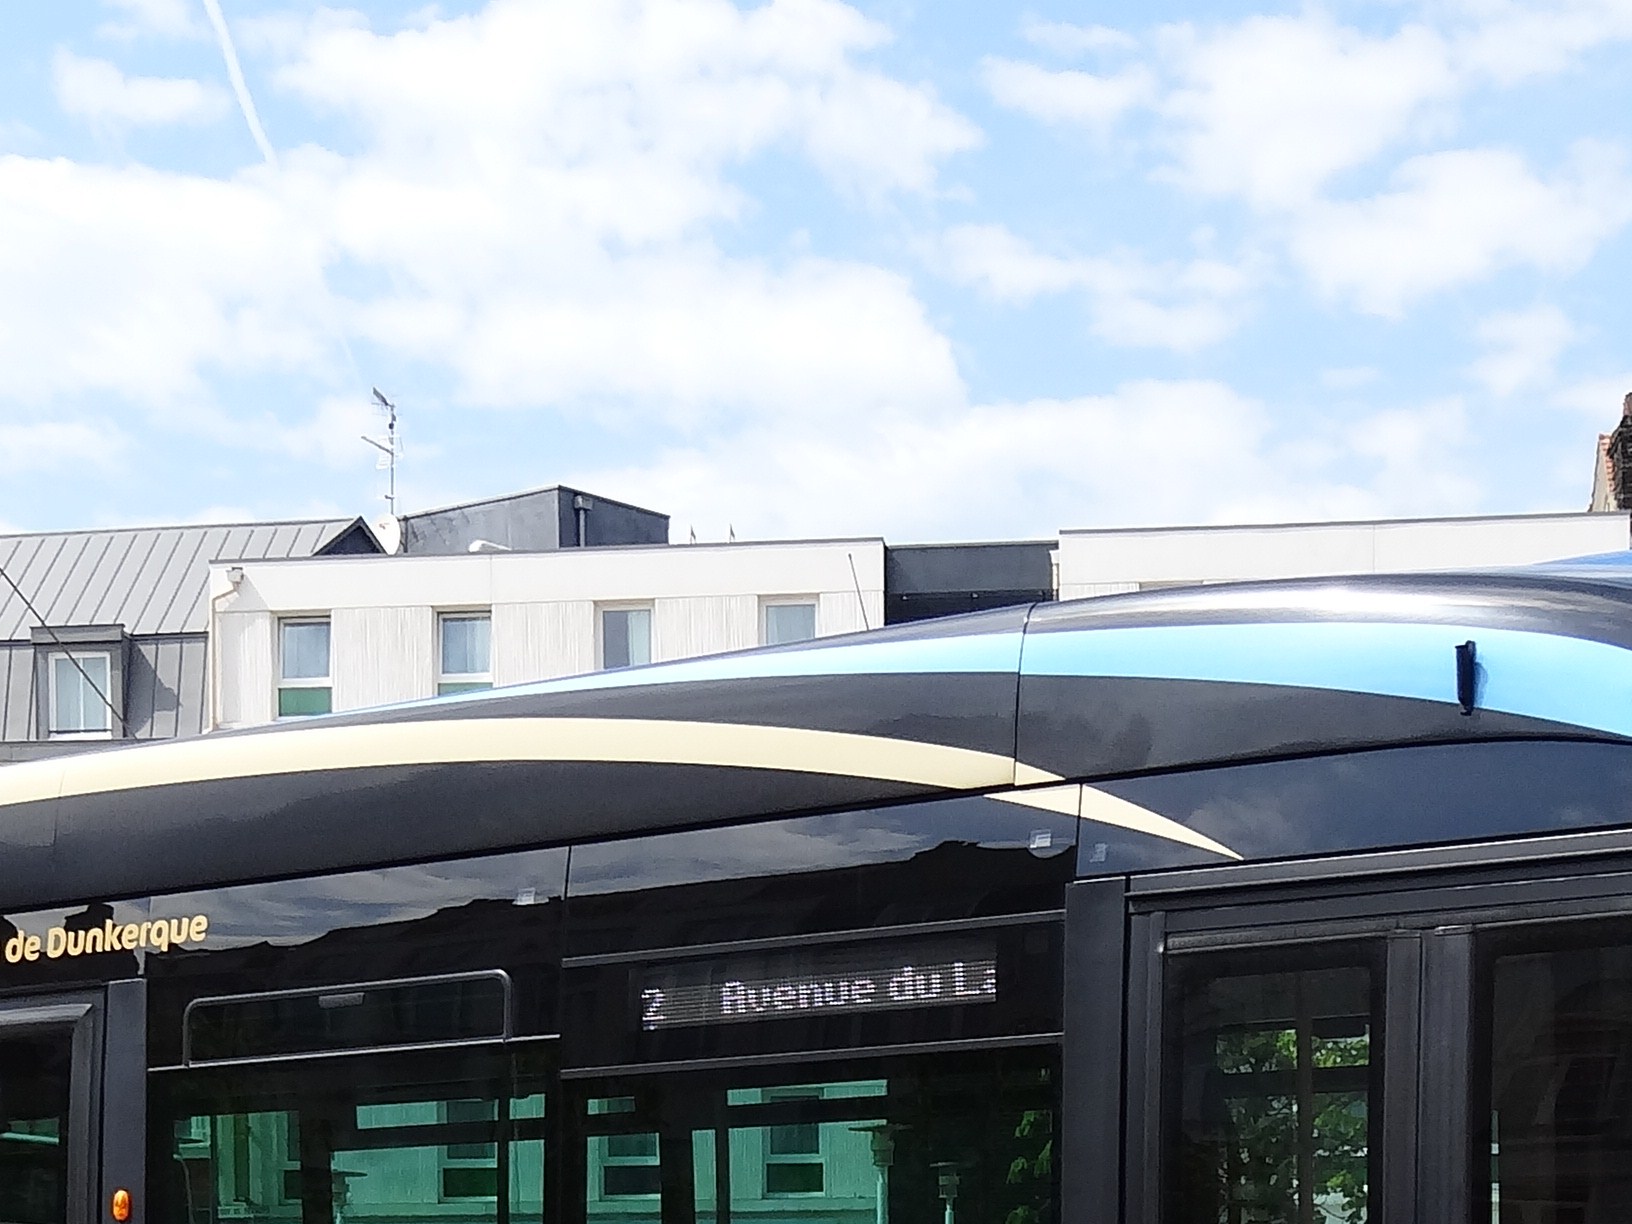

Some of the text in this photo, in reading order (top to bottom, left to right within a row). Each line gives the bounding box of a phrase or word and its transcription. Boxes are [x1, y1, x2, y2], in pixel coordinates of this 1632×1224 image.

[5, 930, 40, 963] de
[47, 914, 208, 959] Dunkerque
[641, 988, 666, 1022] 2
[721, 980, 876, 1015] Avenue
[889, 965, 941, 1001] du
